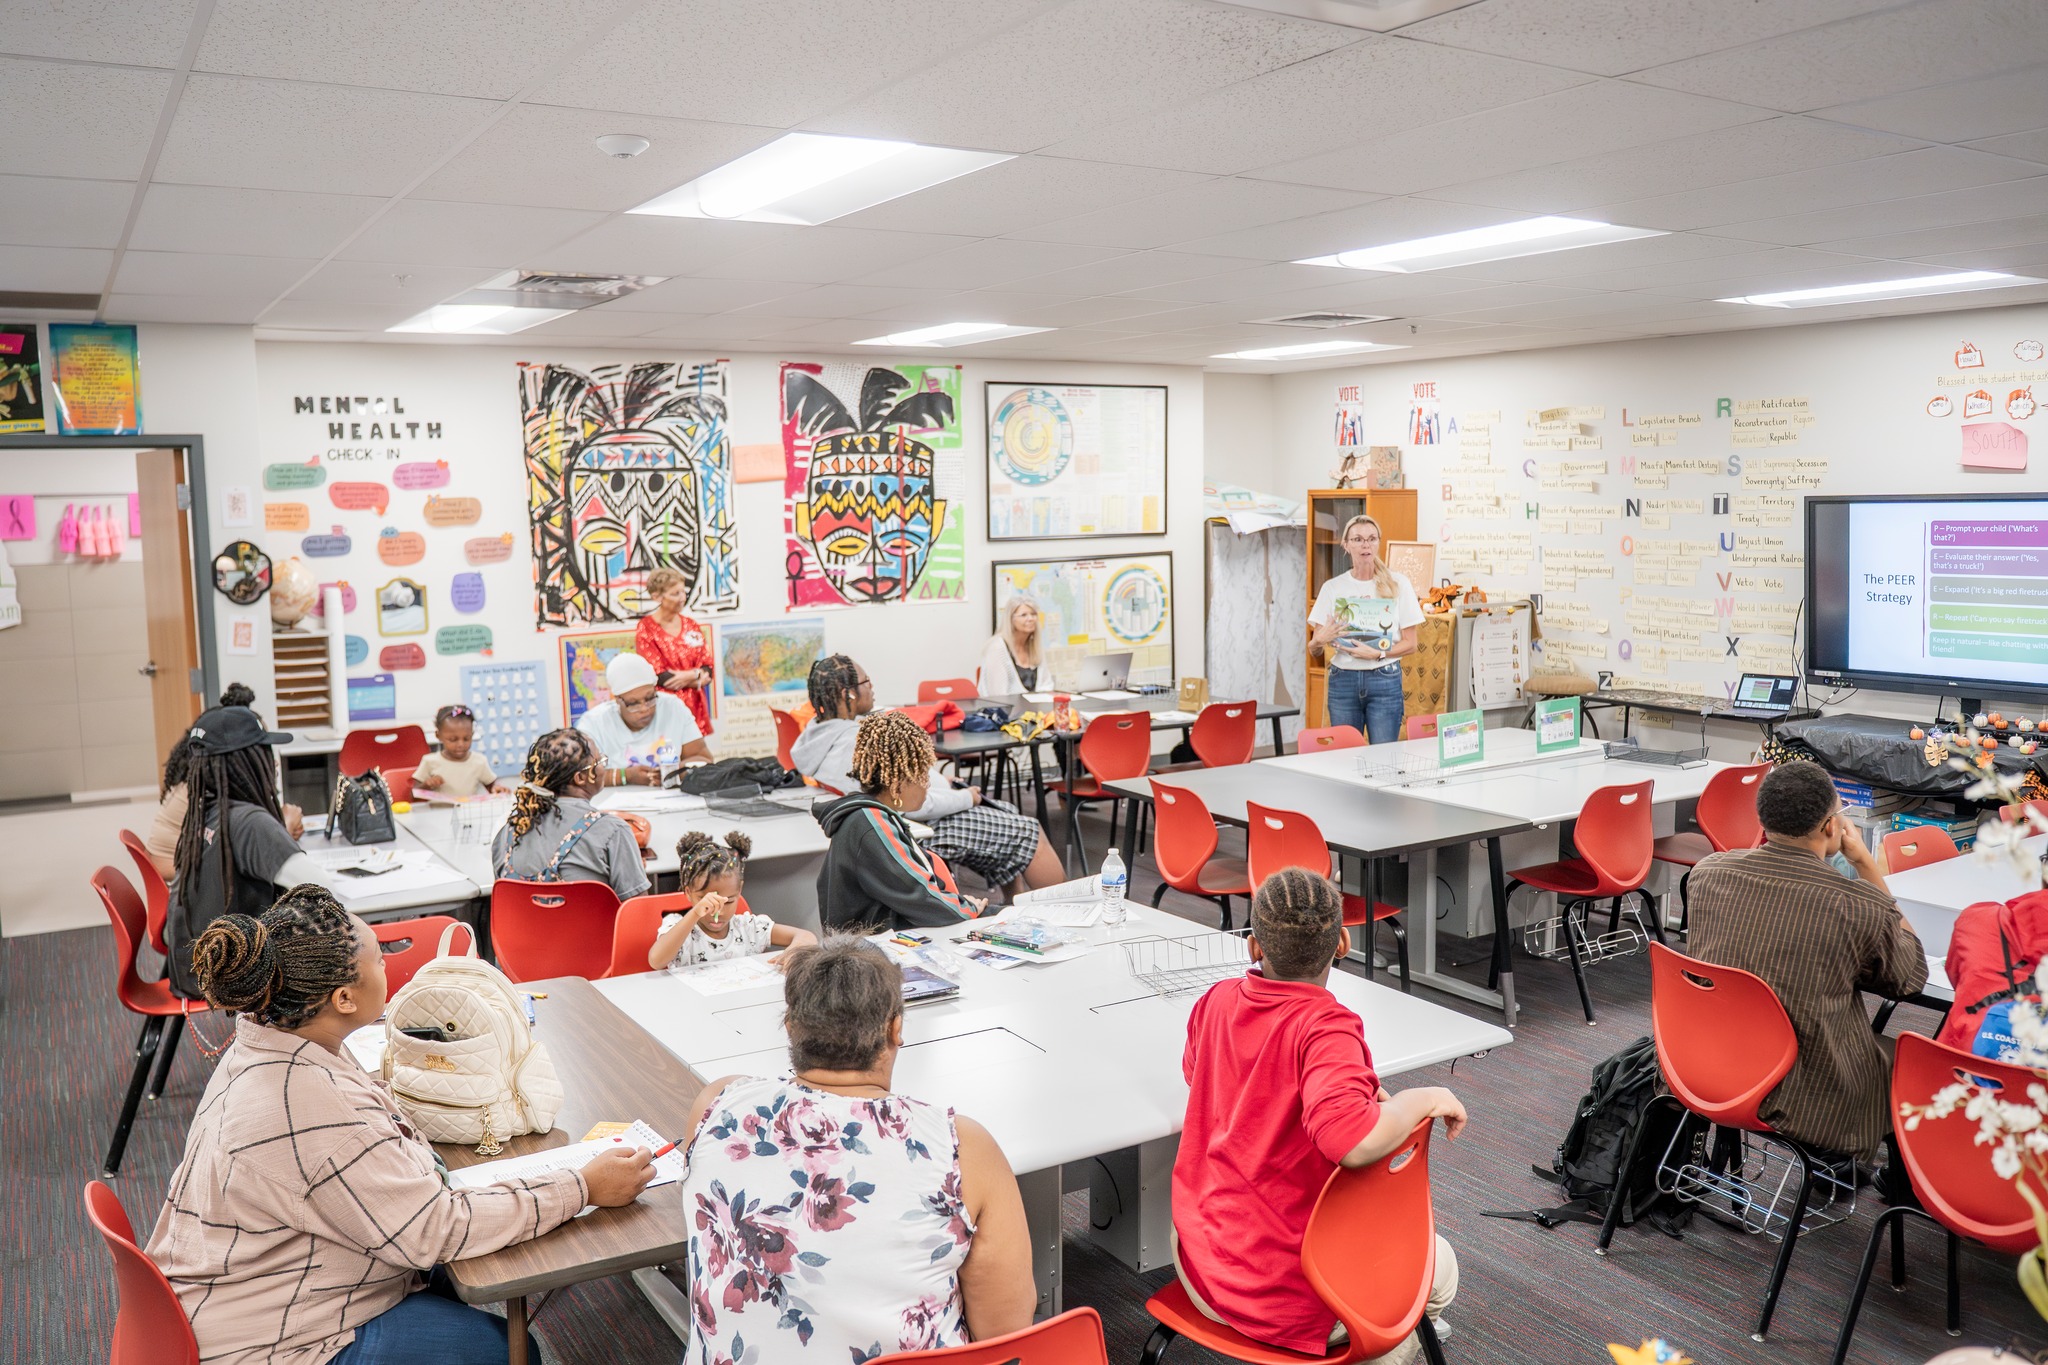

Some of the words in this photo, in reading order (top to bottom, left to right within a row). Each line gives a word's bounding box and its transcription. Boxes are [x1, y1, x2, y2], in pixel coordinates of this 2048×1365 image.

[1937, 377, 1966, 386] Blessed
[1978, 375, 1988, 384] the
[1338, 386, 1360, 401] VOTE
[1413, 382, 1437, 399] VOTE
[1717, 398, 1732, 418] R
[1761, 399, 1808, 409] Ratification
[1540, 408, 1570, 420] Fugitive
[1622, 408, 1634, 427] L
[1447, 416, 1459, 434] A
[1535, 421, 1561, 431] Freedom
[1639, 416, 1676, 429] Legislative
[1678, 414, 1702, 424] Branch
[1733, 417, 1788, 428] Reconstruction
[328, 422, 442, 439] HEALTH
[1574, 437, 1600, 446] Federal
[1632, 434, 1657, 447] Liberty
[1769, 432, 1798, 445] Republic
[1971, 428, 2018, 456] SOUTH
[327, 448, 374, 461] CHECK
[1563, 461, 1605, 472] Government
[1621, 456, 1636, 475] M
[1665, 460, 1697, 470] Manifest
[1697, 460, 1718, 473] Destiny
[1727, 454, 1742, 477] S
[1796, 458, 1828, 468] Secession
[1541, 480, 1559, 488] Great
[1634, 476, 1666, 489] Monarchy
[1745, 477, 1785, 490] Sovereignty
[1787, 475, 1821, 489] Suffrage
[1442, 484, 1453, 501] B
[1626, 498, 1640, 517] N
[1646, 501, 1666, 509] Nadir
[1713, 493, 1729, 514] T
[1760, 496, 1796, 509] Territory
[1526, 502, 1540, 520] H
[1541, 506, 1559, 514] House
[1568, 505, 1616, 517] Representatives
[1737, 513, 1760, 526] Treaty
[1945, 525, 1971, 534] Prompt
[1972, 526, 1989, 534] your
[1989, 524, 2007, 533] child
[1620, 535, 1634, 556] O
[1719, 531, 1735, 552] U
[1738, 537, 1761, 549] Unjust
[1764, 537, 1784, 546] Union
[1544, 549, 1572, 559] Industrial
[1574, 550, 1605, 559] Revolution
[1731, 554, 1777, 567] Underground
[1933, 553, 1938, 561] E
[1945, 553, 1974, 561] Evaluate
[1975, 552, 1992, 561] their
[1993, 554, 2019, 562] answer
[1576, 565, 1612, 577] Independence
[1716, 572, 1733, 592] V
[1735, 577, 1754, 587] Veto
[1763, 579, 1784, 589] Vote
[1863, 573, 1884, 585] The
[1887, 574, 1916, 586] PEER
[1866, 591, 1913, 606] Strategy
[1944, 586, 1969, 596] Expand
[1993, 586, 2004, 598] big
[2005, 587, 2018, 596] red
[1568, 602, 1591, 612] Branch
[1690, 601, 1712, 611] Power
[1715, 598, 1735, 618] W
[1735, 603, 1756, 613] World
[1731, 619, 1765, 630] Westward
[1945, 614, 1969, 623] Repeat
[1989, 616, 2002, 625] you
[2003, 616, 2016, 626] say
[1632, 626, 1660, 636] President
[1663, 629, 1699, 641] Plantation
[1565, 642, 1588, 652] Kansas
[1618, 639, 1633, 661] Q
[1725, 636, 1741, 657] X
[1932, 636, 1950, 647] Keep
[2001, 640, 2030, 651] chatting
[1598, 671, 1614, 690] Z
[1723, 680, 1738, 704] Y
[1994, 1033, 2021, 1046] COAST
